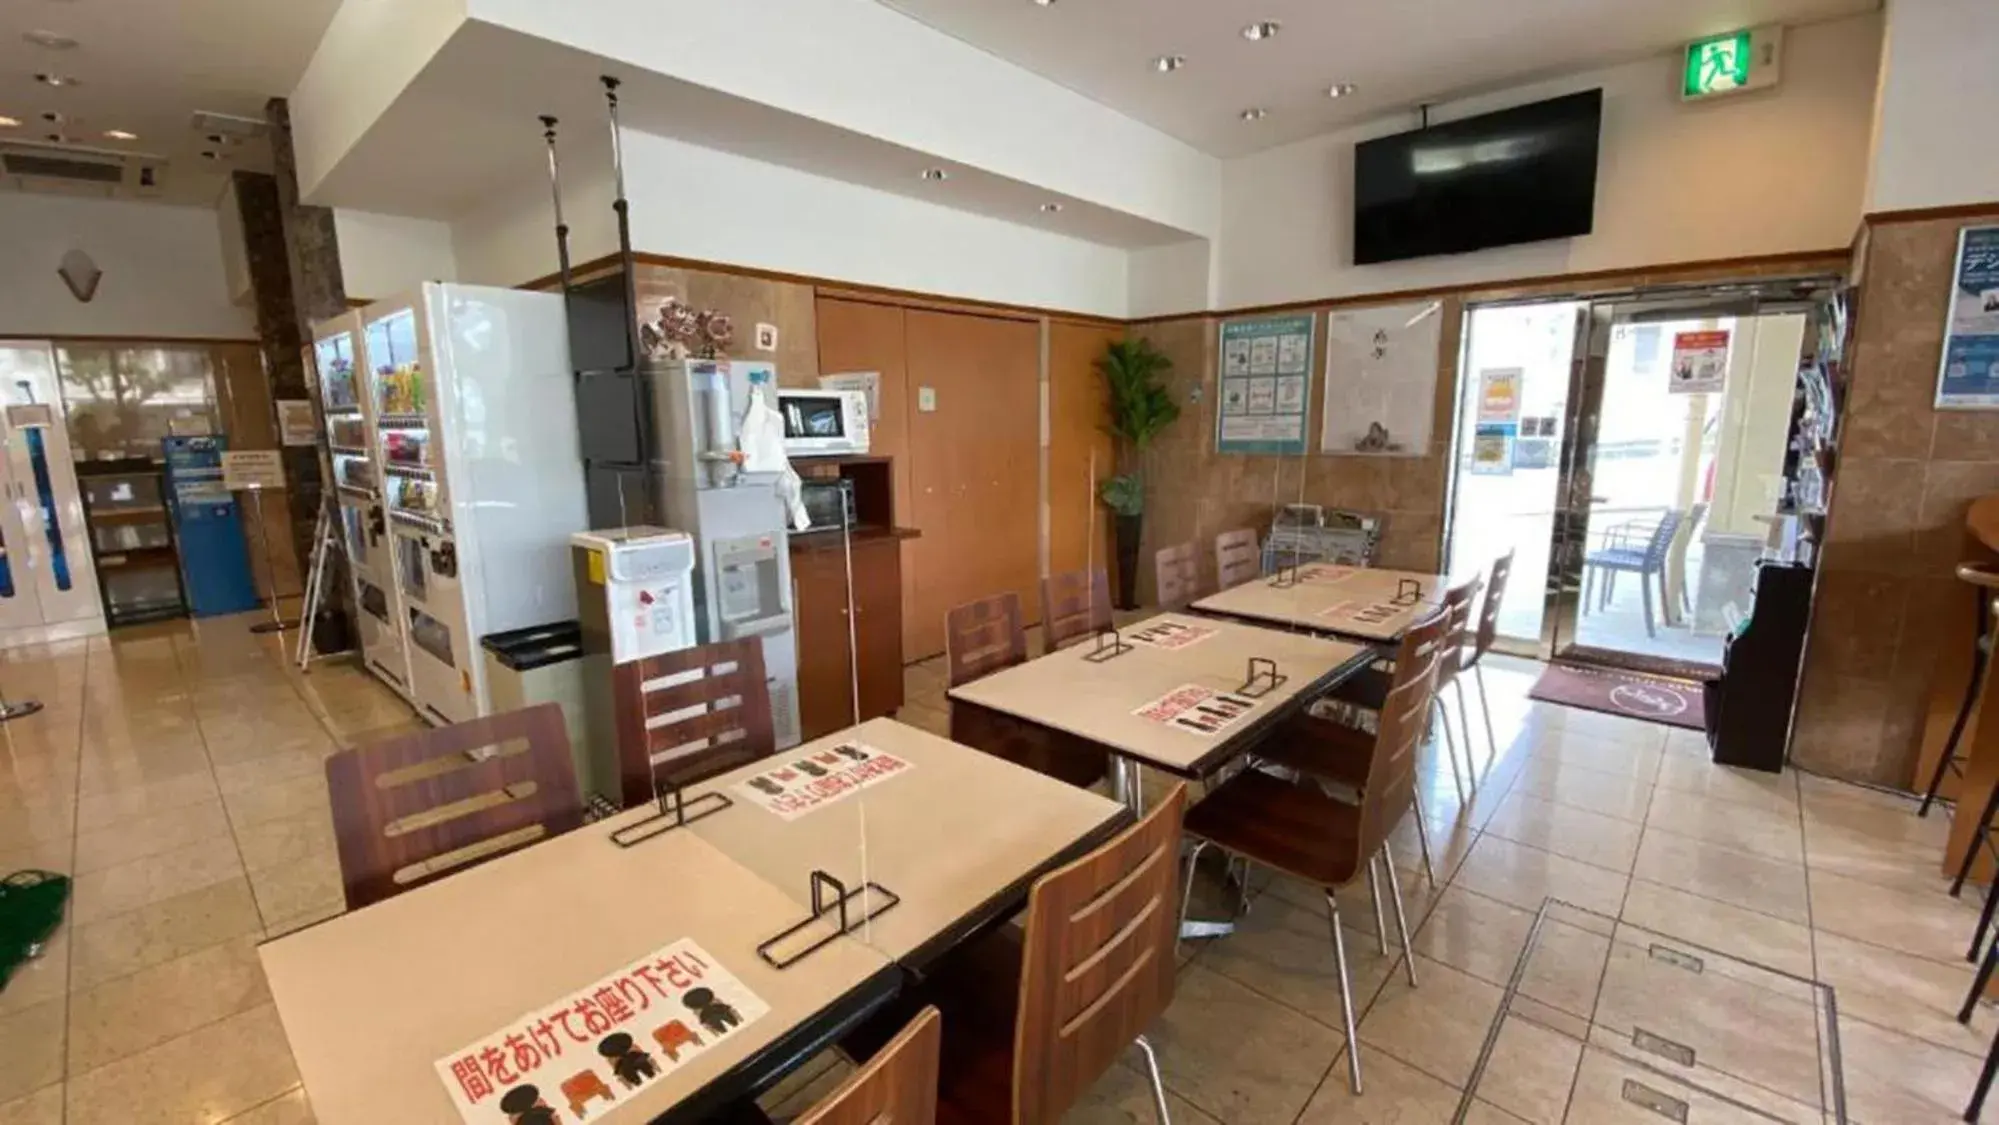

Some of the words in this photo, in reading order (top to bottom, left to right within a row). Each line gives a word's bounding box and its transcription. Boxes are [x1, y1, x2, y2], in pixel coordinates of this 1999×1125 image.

[450, 950, 708, 1104] 間をあけてお座り下さい
